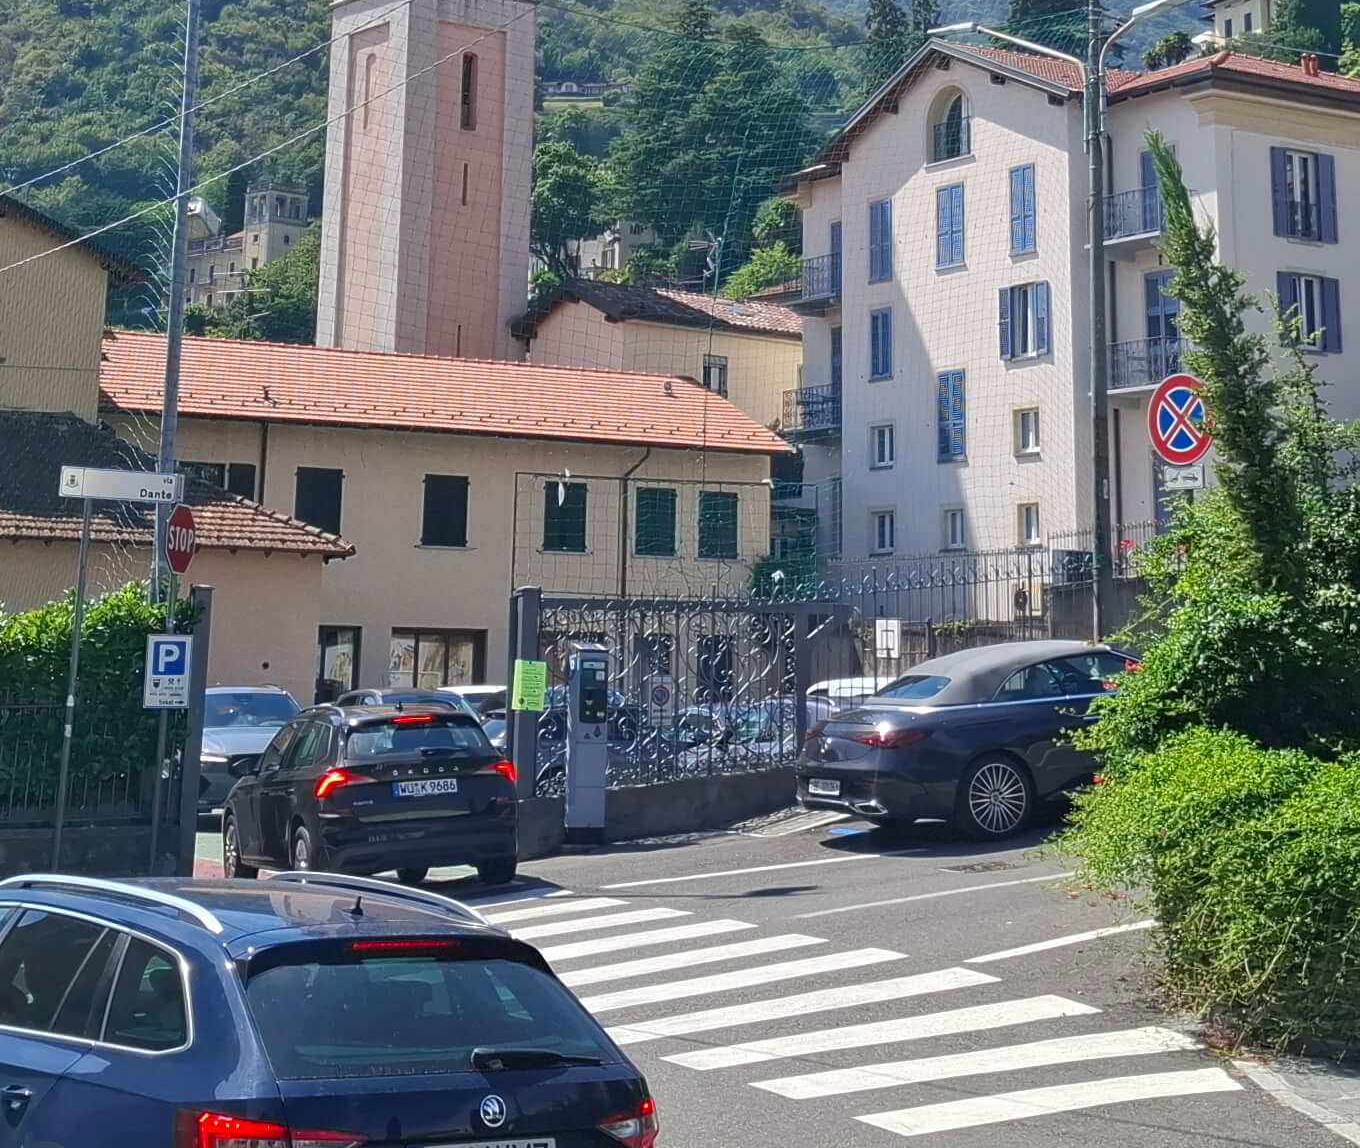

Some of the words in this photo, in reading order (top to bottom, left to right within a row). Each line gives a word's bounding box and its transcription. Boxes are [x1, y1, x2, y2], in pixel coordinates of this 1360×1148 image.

[162, 477, 173, 485] via
[140, 488, 173, 500] Dante
[168, 525, 194, 553] STOP
[158, 644, 180, 672] P
